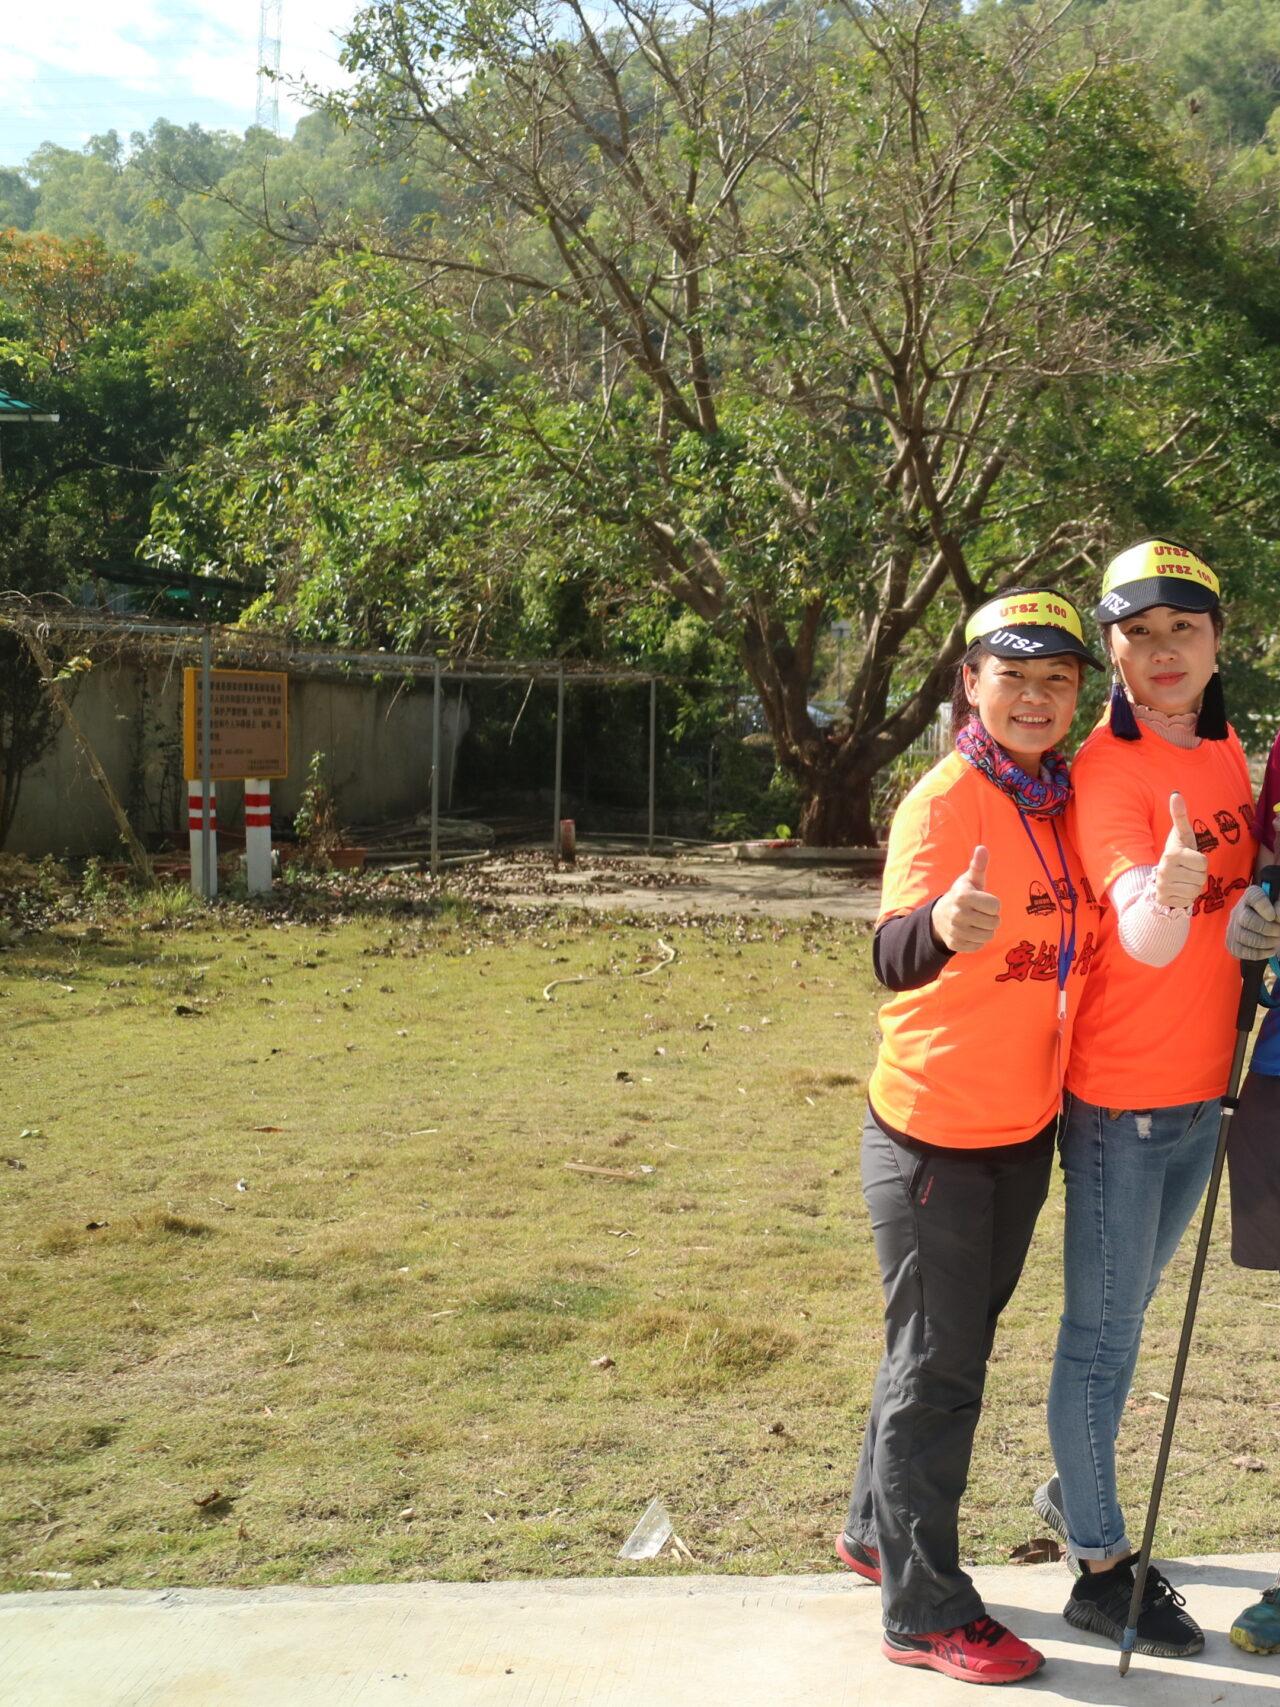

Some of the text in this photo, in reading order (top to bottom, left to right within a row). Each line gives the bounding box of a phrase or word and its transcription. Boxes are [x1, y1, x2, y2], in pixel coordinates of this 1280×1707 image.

[1153, 546, 1189, 558] UTSZ
[1156, 564, 1212, 584] UTSZ 100
[1000, 603, 1067, 618] UTSZ 100
[990, 630, 1044, 653] UTSZ
